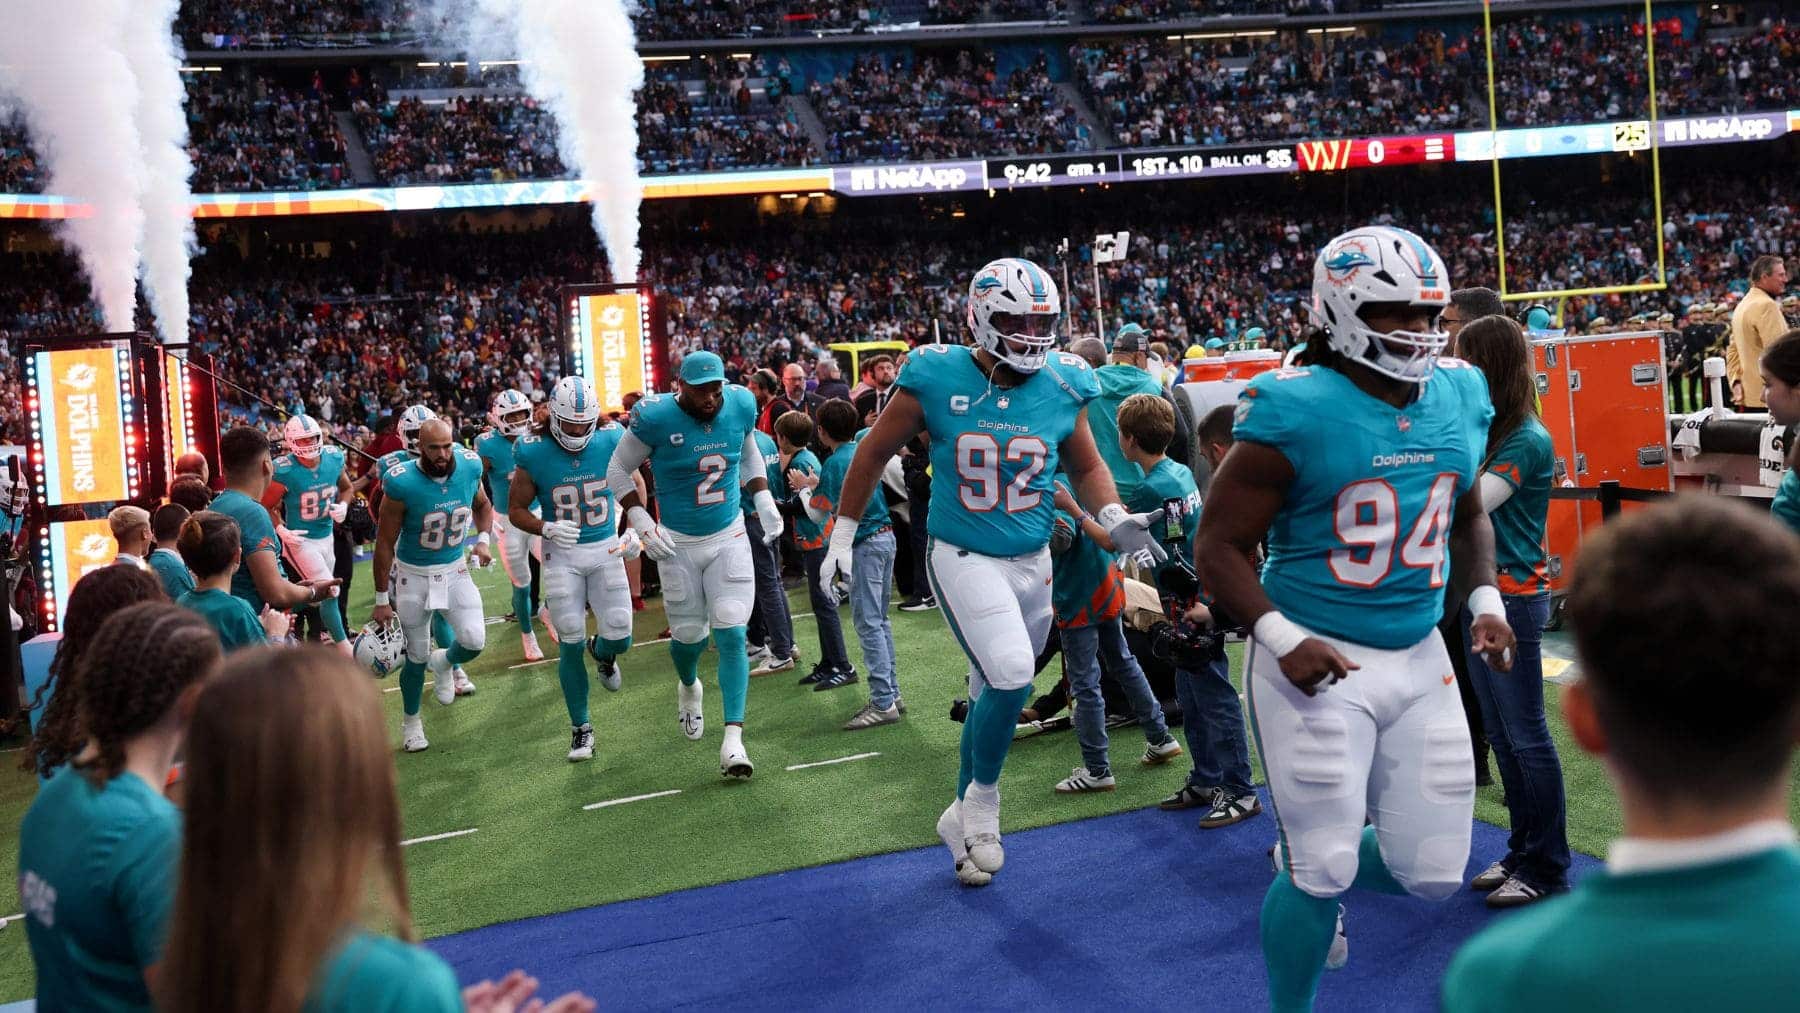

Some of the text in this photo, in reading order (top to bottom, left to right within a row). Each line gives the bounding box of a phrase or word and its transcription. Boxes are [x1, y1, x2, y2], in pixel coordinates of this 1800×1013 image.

[1616, 124, 1647, 147] 25
[1689, 117, 1772, 140] NetApp
[1210, 156, 1242, 169] BALL
[1242, 154, 1262, 168] ON
[1266, 149, 1293, 168] 35
[1368, 140, 1385, 163] 0
[878, 166, 967, 190] NetApp
[1003, 162, 1106, 184] 9:42 QTR 1
[1031, 303, 1051, 313] MIAMI
[950, 395, 970, 411] C
[977, 419, 1030, 433] Dolphins
[67, 394, 95, 491] DOLPHINS
[670, 433, 684, 445] C
[693, 442, 728, 454] Dolphins
[1372, 453, 1435, 468] Dolphins
[697, 453, 728, 506] 2
[956, 432, 1048, 515] 92
[300, 485, 338, 520] 87
[552, 479, 610, 528] 85
[420, 506, 471, 551] 89
[1327, 472, 1459, 590] 94
